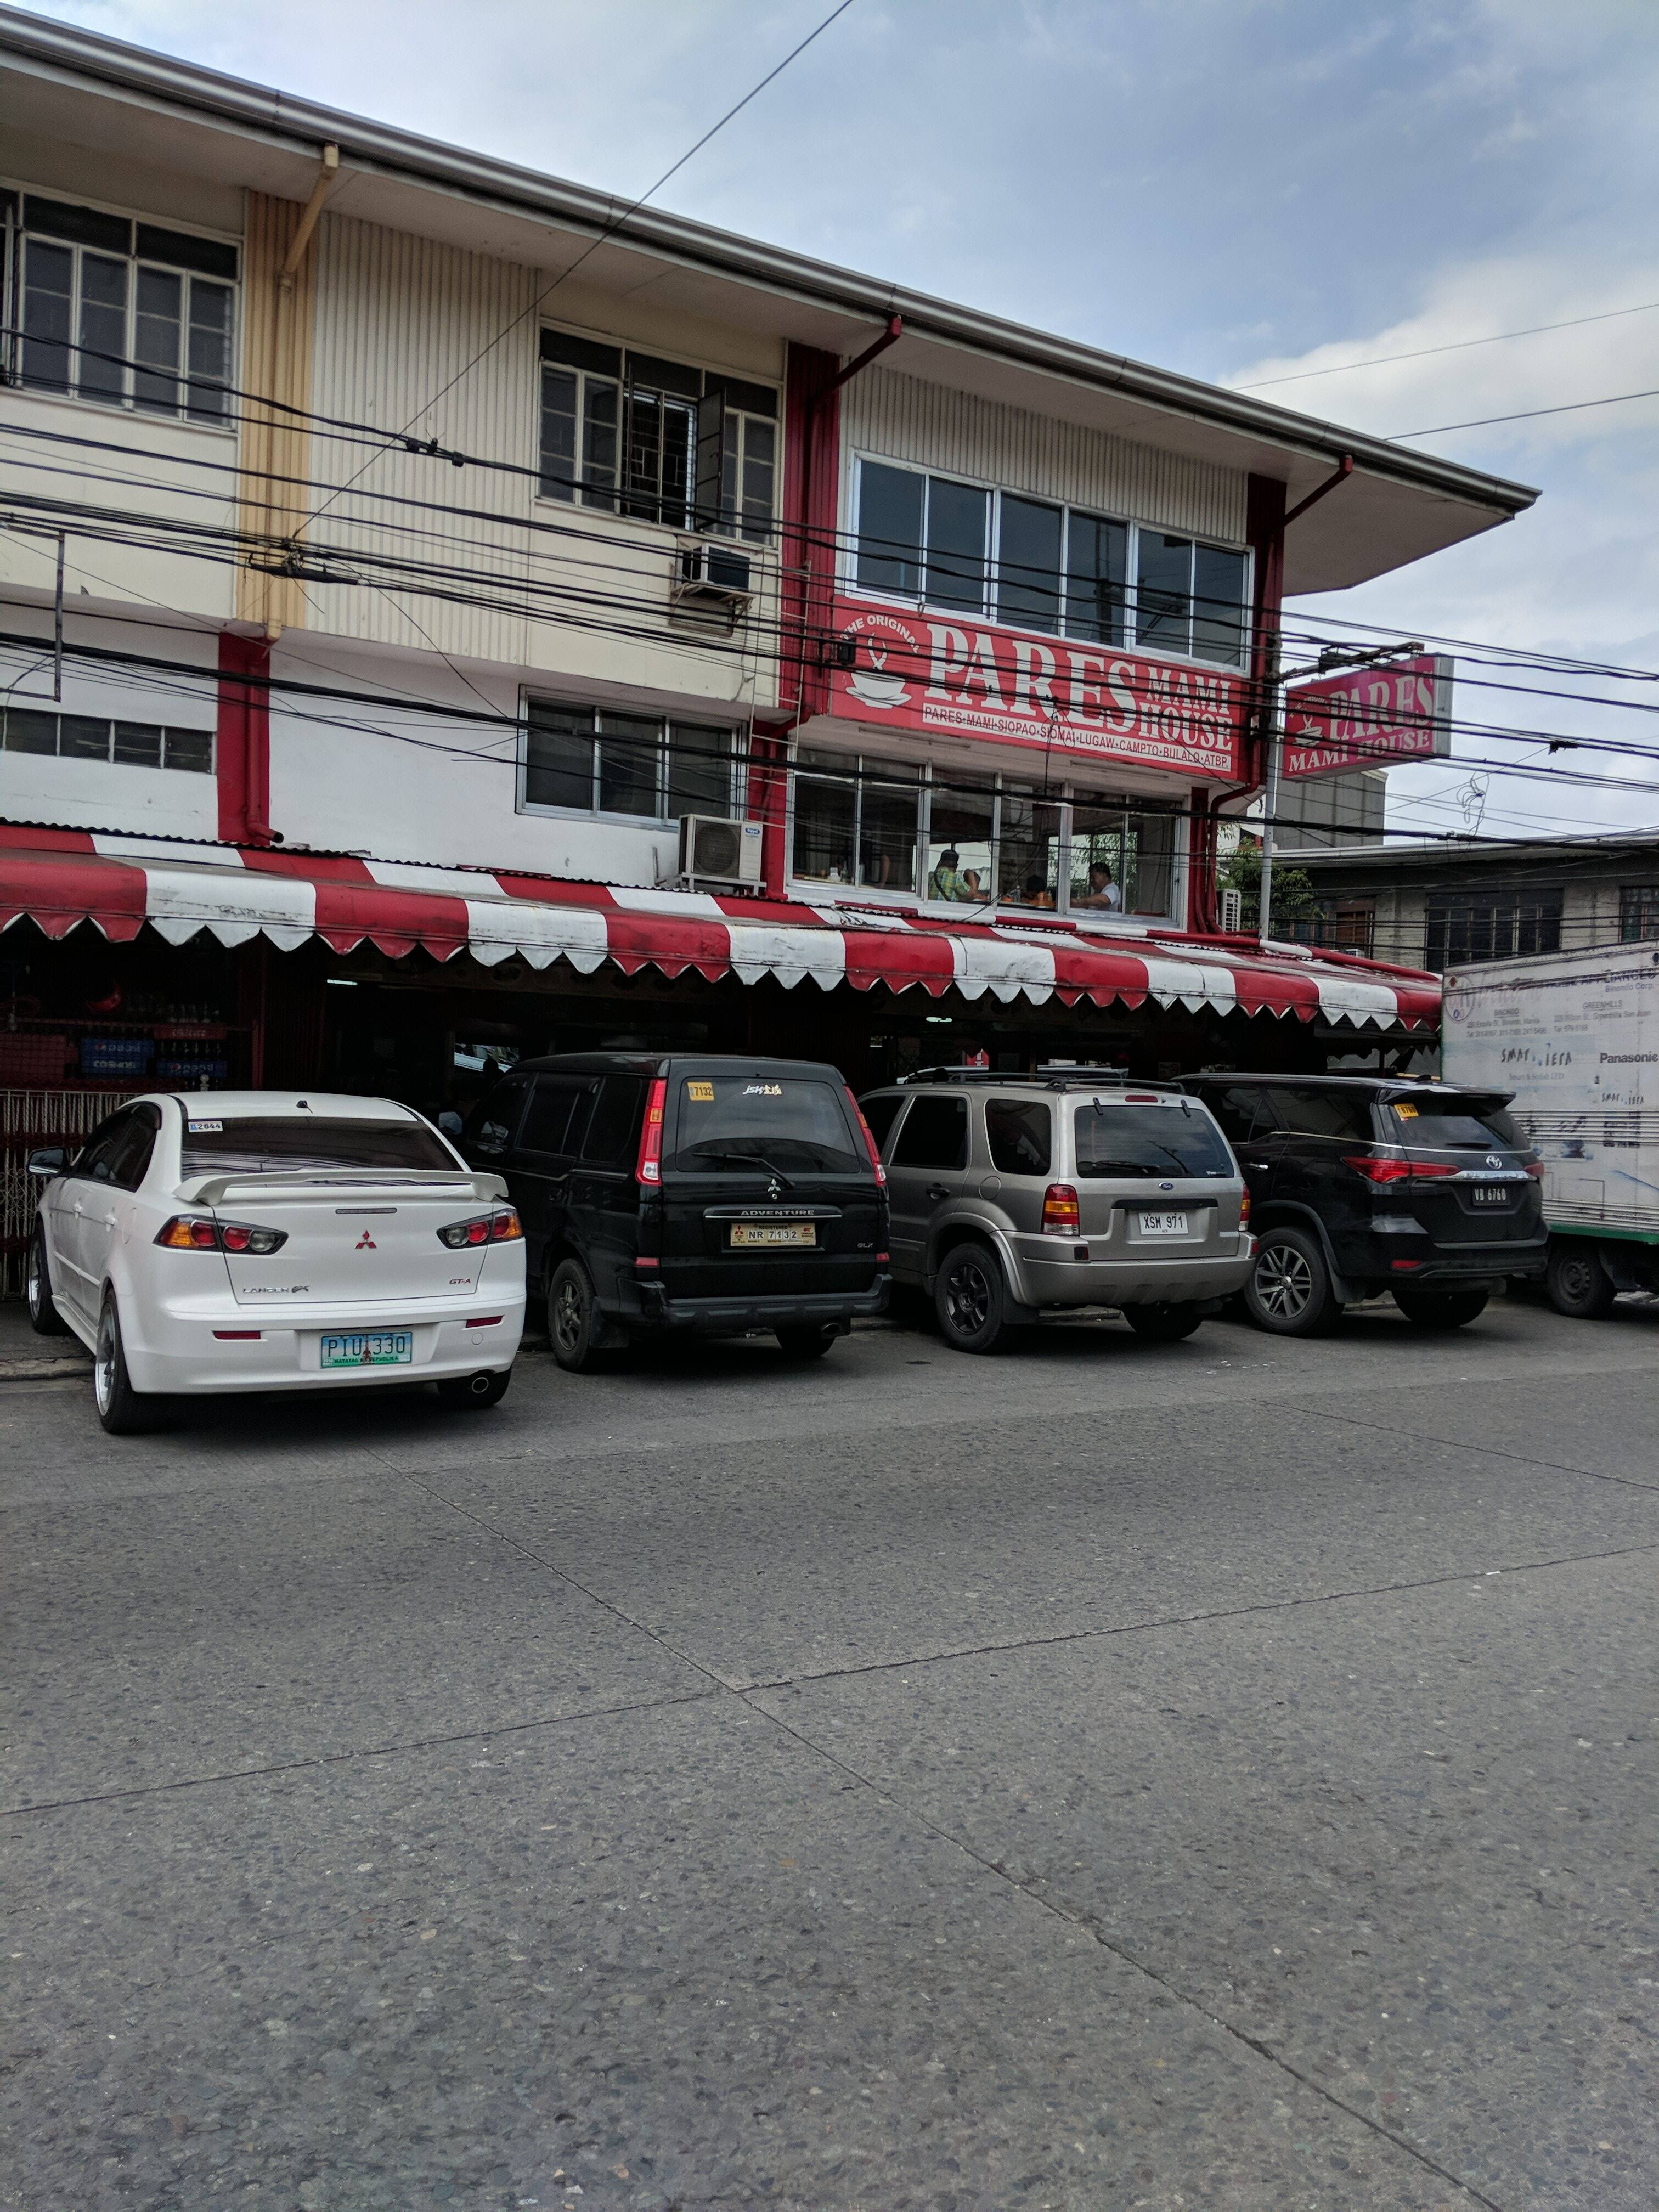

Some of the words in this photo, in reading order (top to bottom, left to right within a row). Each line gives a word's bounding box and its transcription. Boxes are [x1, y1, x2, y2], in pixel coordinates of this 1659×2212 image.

[866, 614, 920, 654] ORIGINAL
[924, 623, 1136, 733] PARES
[1147, 667, 1231, 715] MAMI
[1329, 670, 1434, 741] PARES
[1138, 702, 1232, 751] HOUSE
[1289, 746, 1348, 772] MAMI
[1357, 730, 1430, 760] HOUSE
[1600, 1052, 1659, 1064] Panasonic
[694, 1086, 713, 1096] 7132
[1474, 1188, 1485, 1201] VB
[1487, 1188, 1506, 1201] 6760
[769, 1231, 798, 1239] 7132
[1144, 1216, 1161, 1229] XSM
[1166, 1216, 1183, 1228] 971
[328, 1338, 363, 1357] PIU
[373, 1336, 405, 1355] 330
